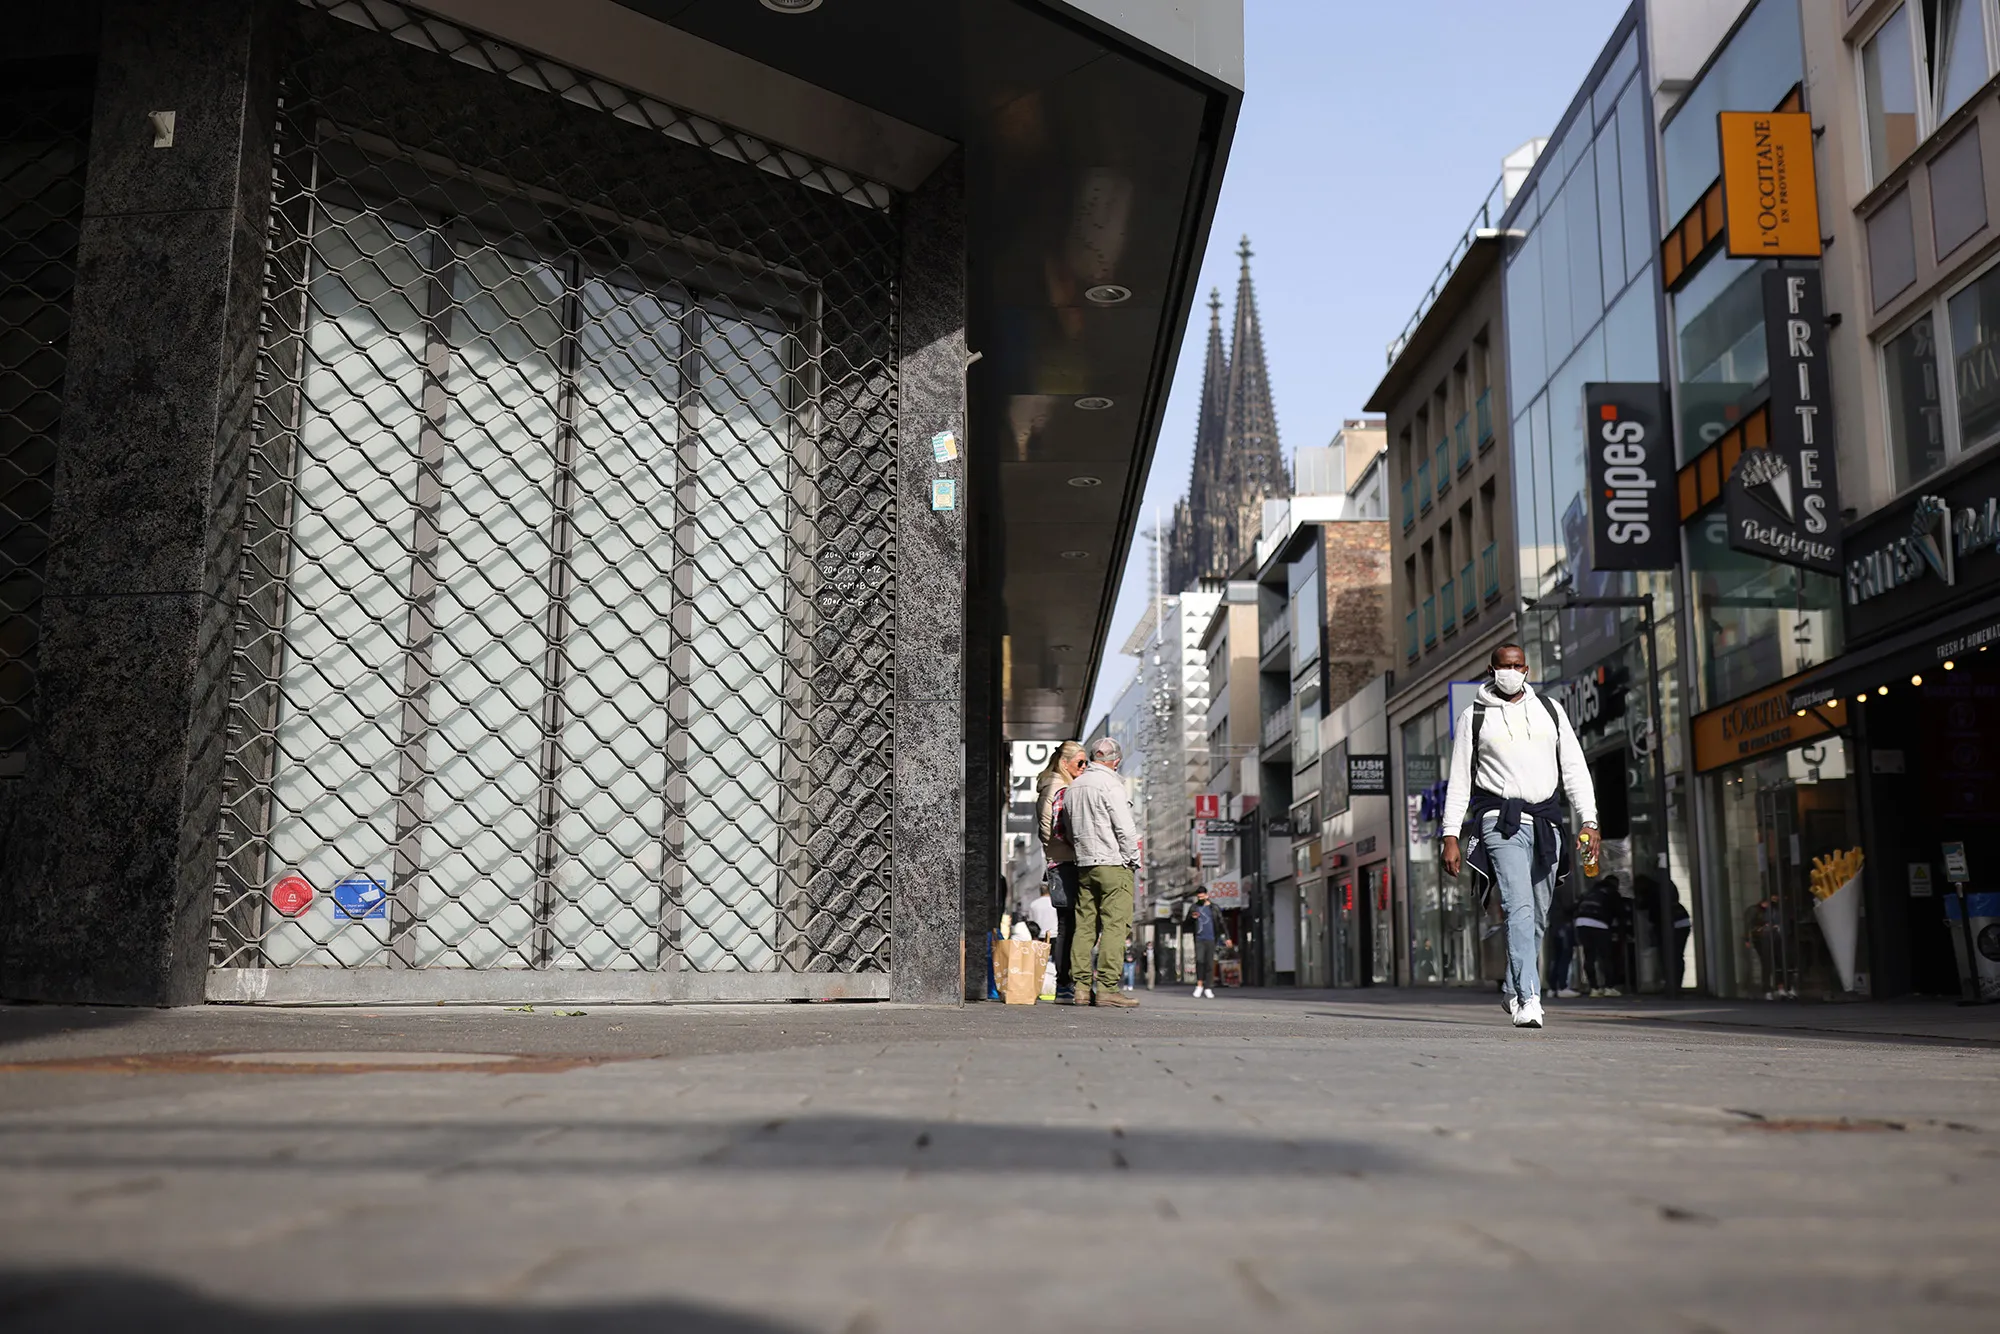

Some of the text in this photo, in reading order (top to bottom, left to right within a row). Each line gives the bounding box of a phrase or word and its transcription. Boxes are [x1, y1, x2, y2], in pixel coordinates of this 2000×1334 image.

[1755, 120, 1779, 248] L'OCCITANE
[1776, 144, 1790, 223] EN PROVENCE
[1787, 277, 1828, 534] FRITES
[1601, 420, 1657, 545] snipes
[1741, 518, 1836, 562] Belgique
[1558, 668, 1600, 737] nipes
[1351, 760, 1384, 770] LUSH
[1351, 770, 1384, 779] FRESH
